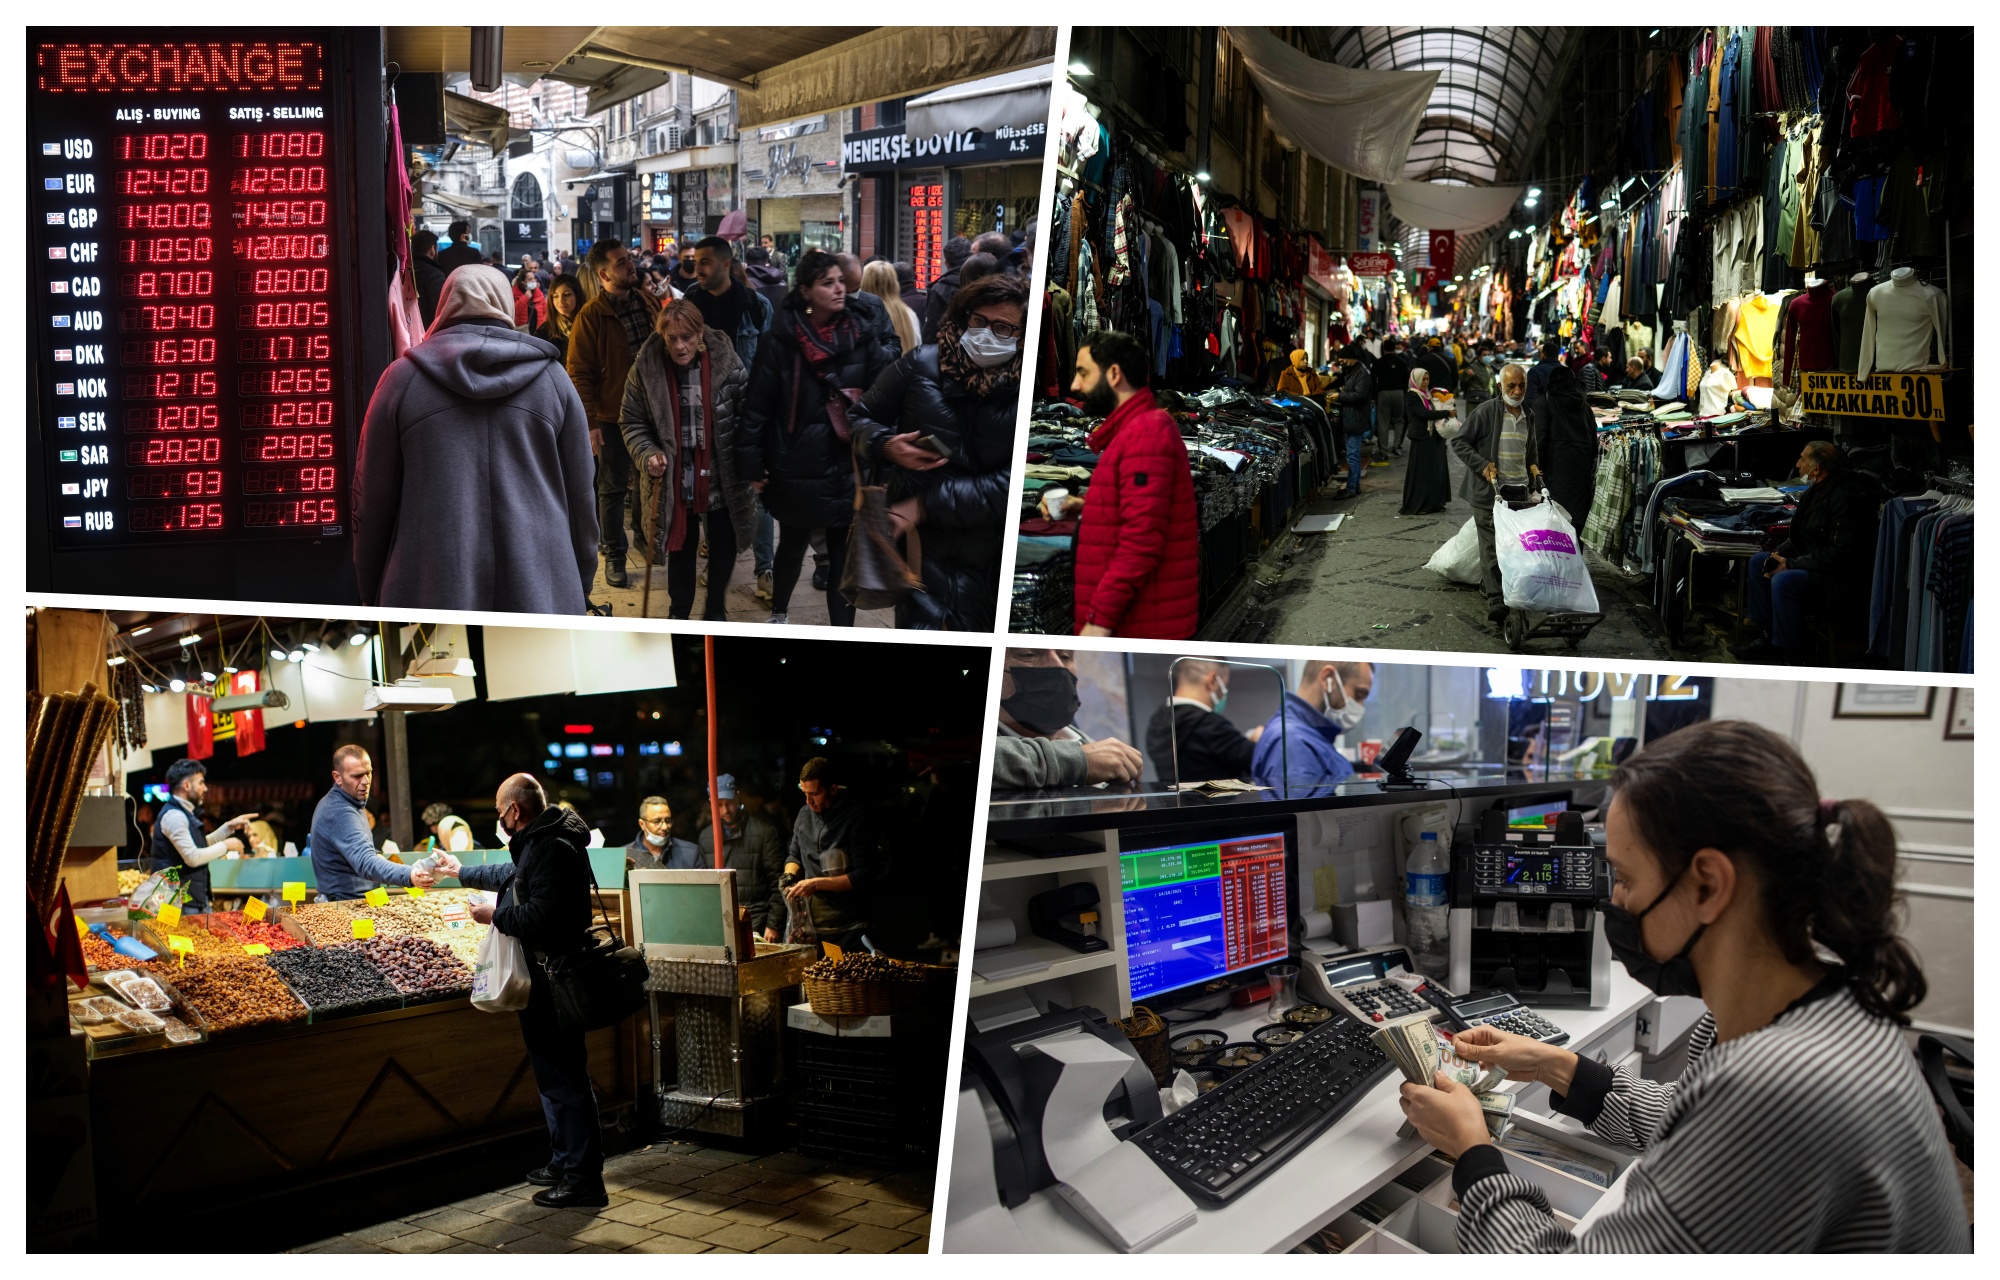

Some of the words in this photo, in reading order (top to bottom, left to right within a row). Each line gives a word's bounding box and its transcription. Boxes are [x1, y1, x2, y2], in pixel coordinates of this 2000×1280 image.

[60, 48, 303, 83] EXCHANGE
[116, 109, 143, 123] ALIŞ
[153, 108, 201, 120] BUYING
[229, 107, 263, 122] SATIŞ
[273, 107, 323, 119] SELLING
[64, 139, 93, 159] USD
[843, 134, 911, 164] MENEKŞE
[66, 174, 95, 194] EUR
[68, 208, 97, 228] GBP
[70, 242, 98, 262] CHF
[72, 277, 100, 297] CAD
[139, 271, 213, 296] 8.700
[74, 311, 103, 331] AUD
[75, 345, 104, 364] DKK
[77, 378, 107, 398] NOK
[1830, 375, 1846, 390] VE
[1849, 376, 1892, 391] ESNEK
[1803, 392, 1900, 416] KAZAKLAR
[1901, 375, 1933, 419] 30
[1934, 408, 1944, 418] TL
[79, 412, 107, 431] SEK
[81, 445, 109, 465] SAR
[83, 478, 109, 498] JPY
[85, 511, 114, 531] RUB
[1522, 871, 1552, 882] 2,115
